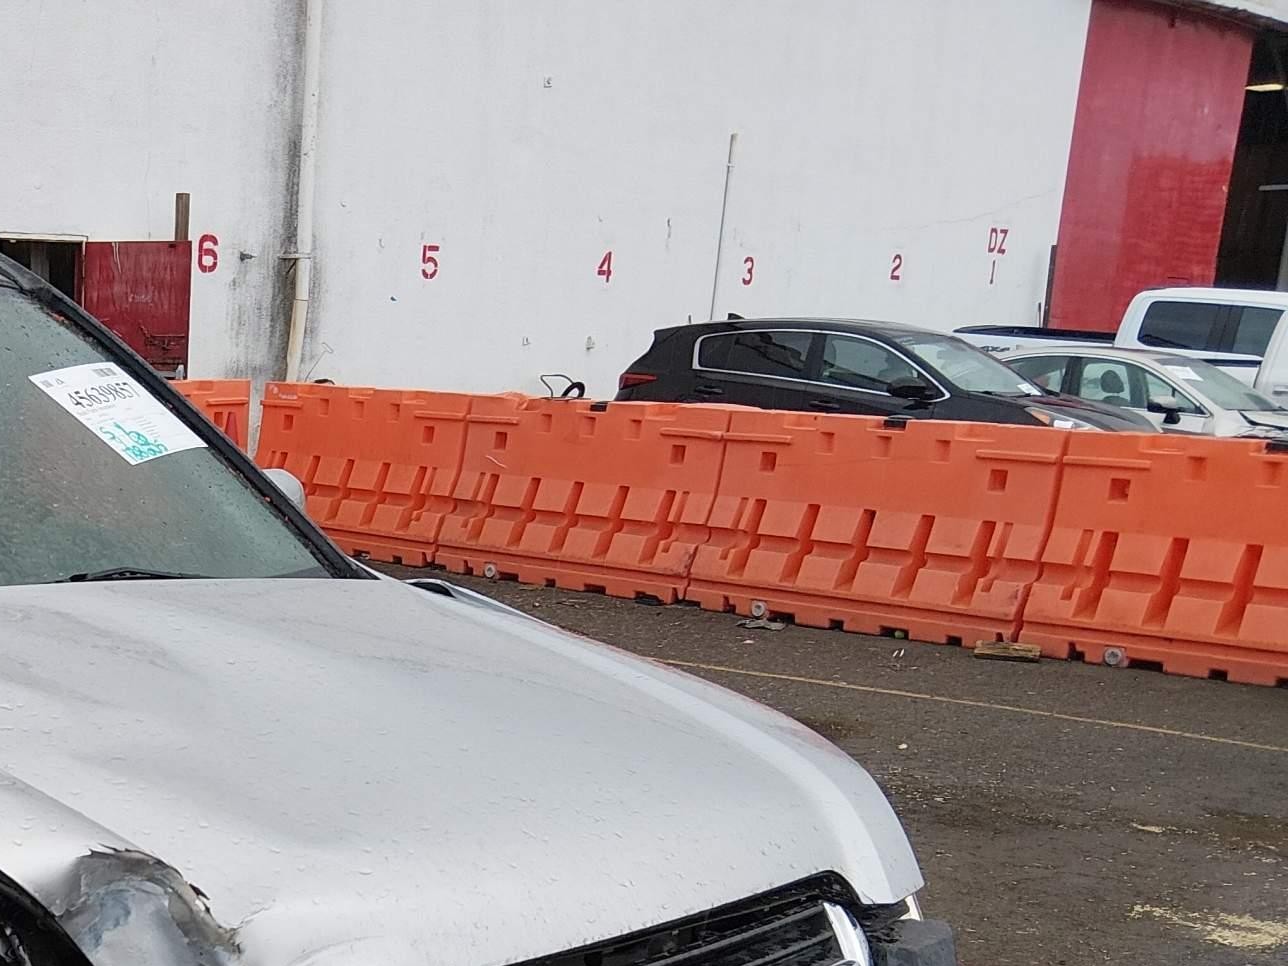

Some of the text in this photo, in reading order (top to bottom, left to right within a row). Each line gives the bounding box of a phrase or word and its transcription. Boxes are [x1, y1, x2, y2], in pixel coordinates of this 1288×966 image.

[197, 234, 218, 273] 6
[987, 227, 1009, 255] DZ
[422, 245, 440, 280] 5
[596, 251, 612, 283] 4
[741, 256, 755, 286] 3
[889, 254, 903, 281] 2
[989, 259, 996, 285] 1
[67, 382, 140, 408] 45639857
